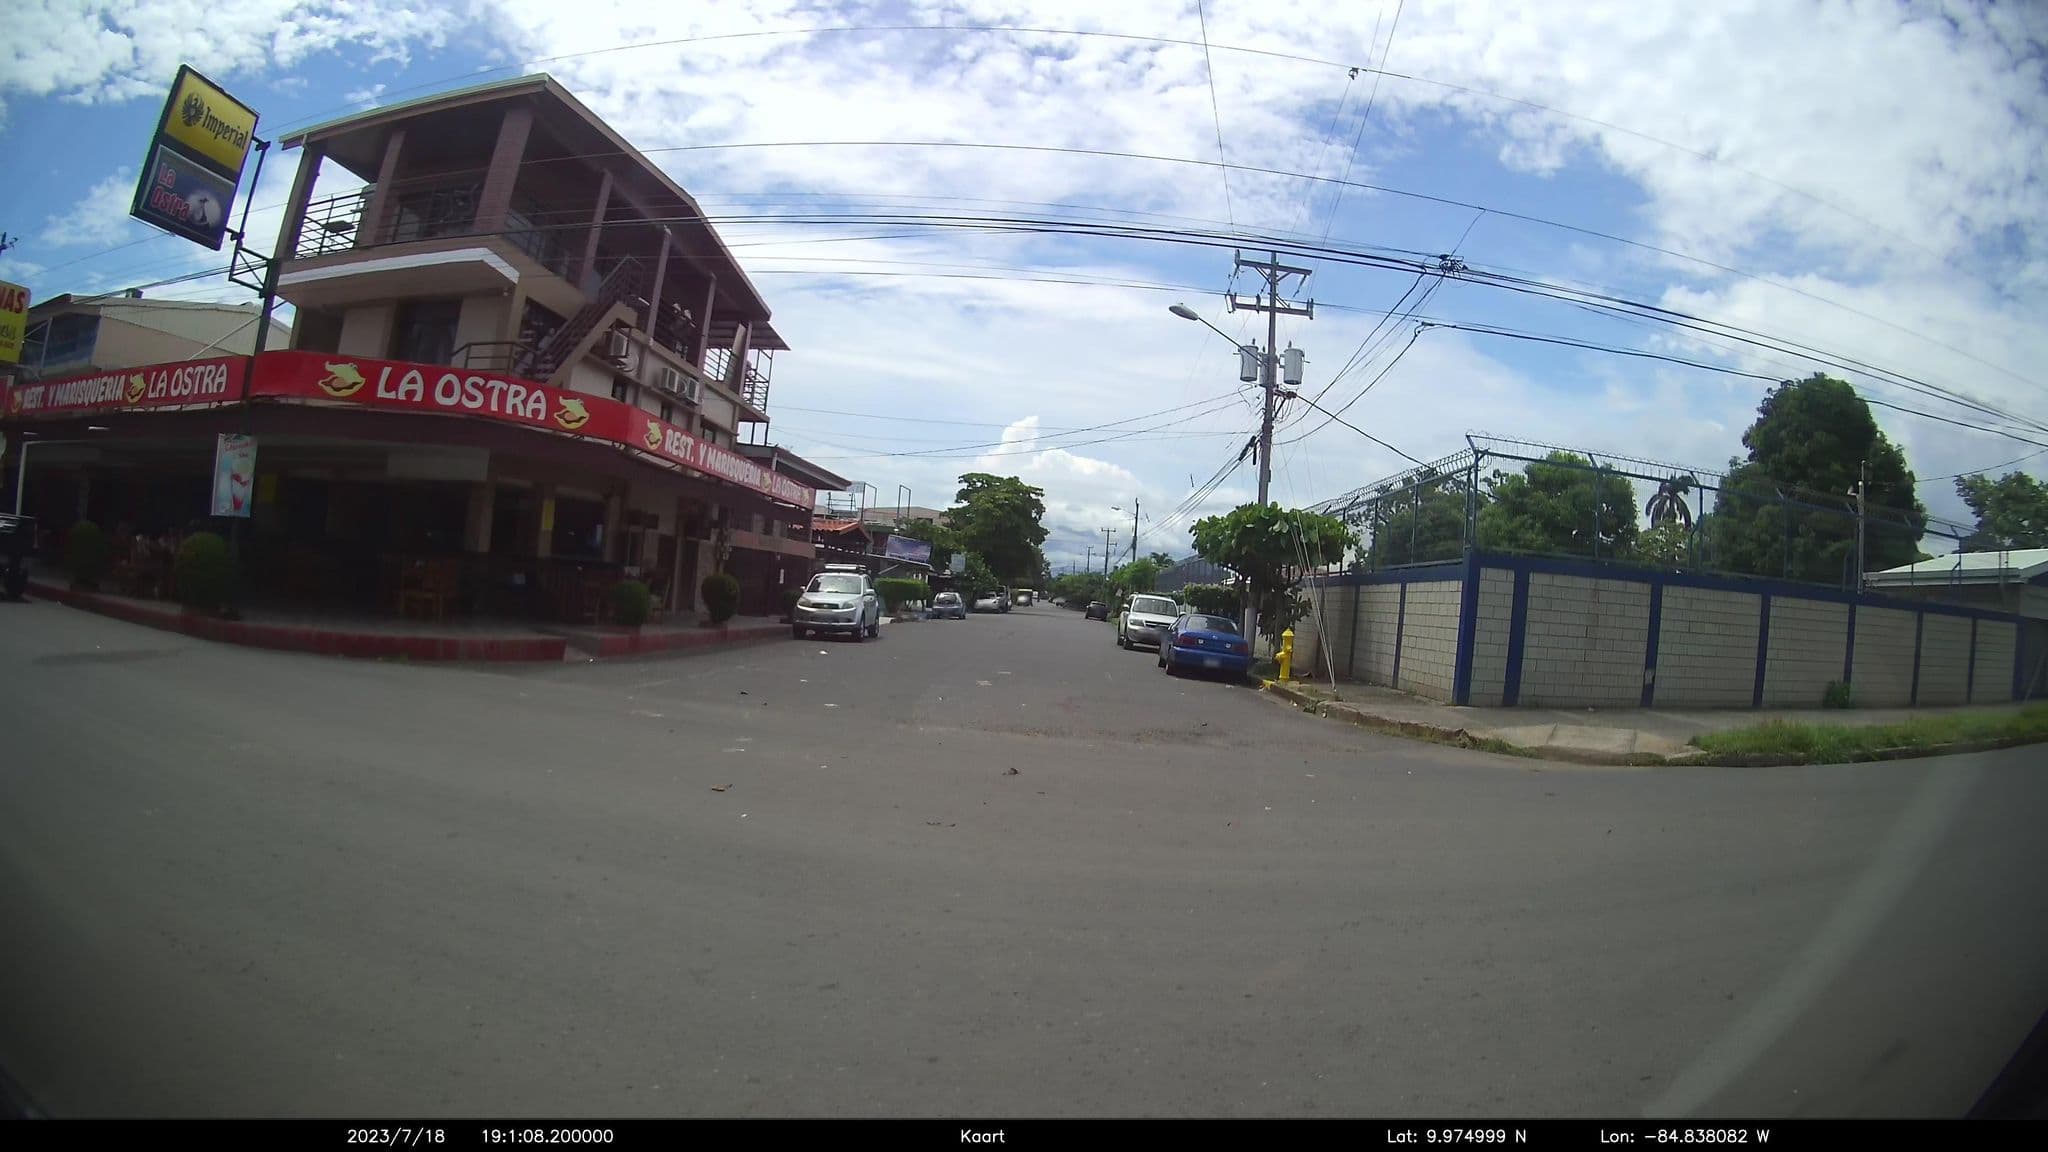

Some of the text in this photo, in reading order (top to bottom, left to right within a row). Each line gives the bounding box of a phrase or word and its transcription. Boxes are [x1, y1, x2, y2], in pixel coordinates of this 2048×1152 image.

[202, 106, 249, 149] Imperial
[159, 163, 176, 188] La
[151, 187, 191, 221] Ostra
[50, 384, 57, 407] Y
[55, 374, 126, 407] MARISQUERIA
[148, 363, 228, 398] LA OSTRA
[377, 366, 548, 420] LA OSTRA
[664, 428, 761, 487] REST. Y MARISQUERIA
[771, 474, 802, 502] LA OSTRA
